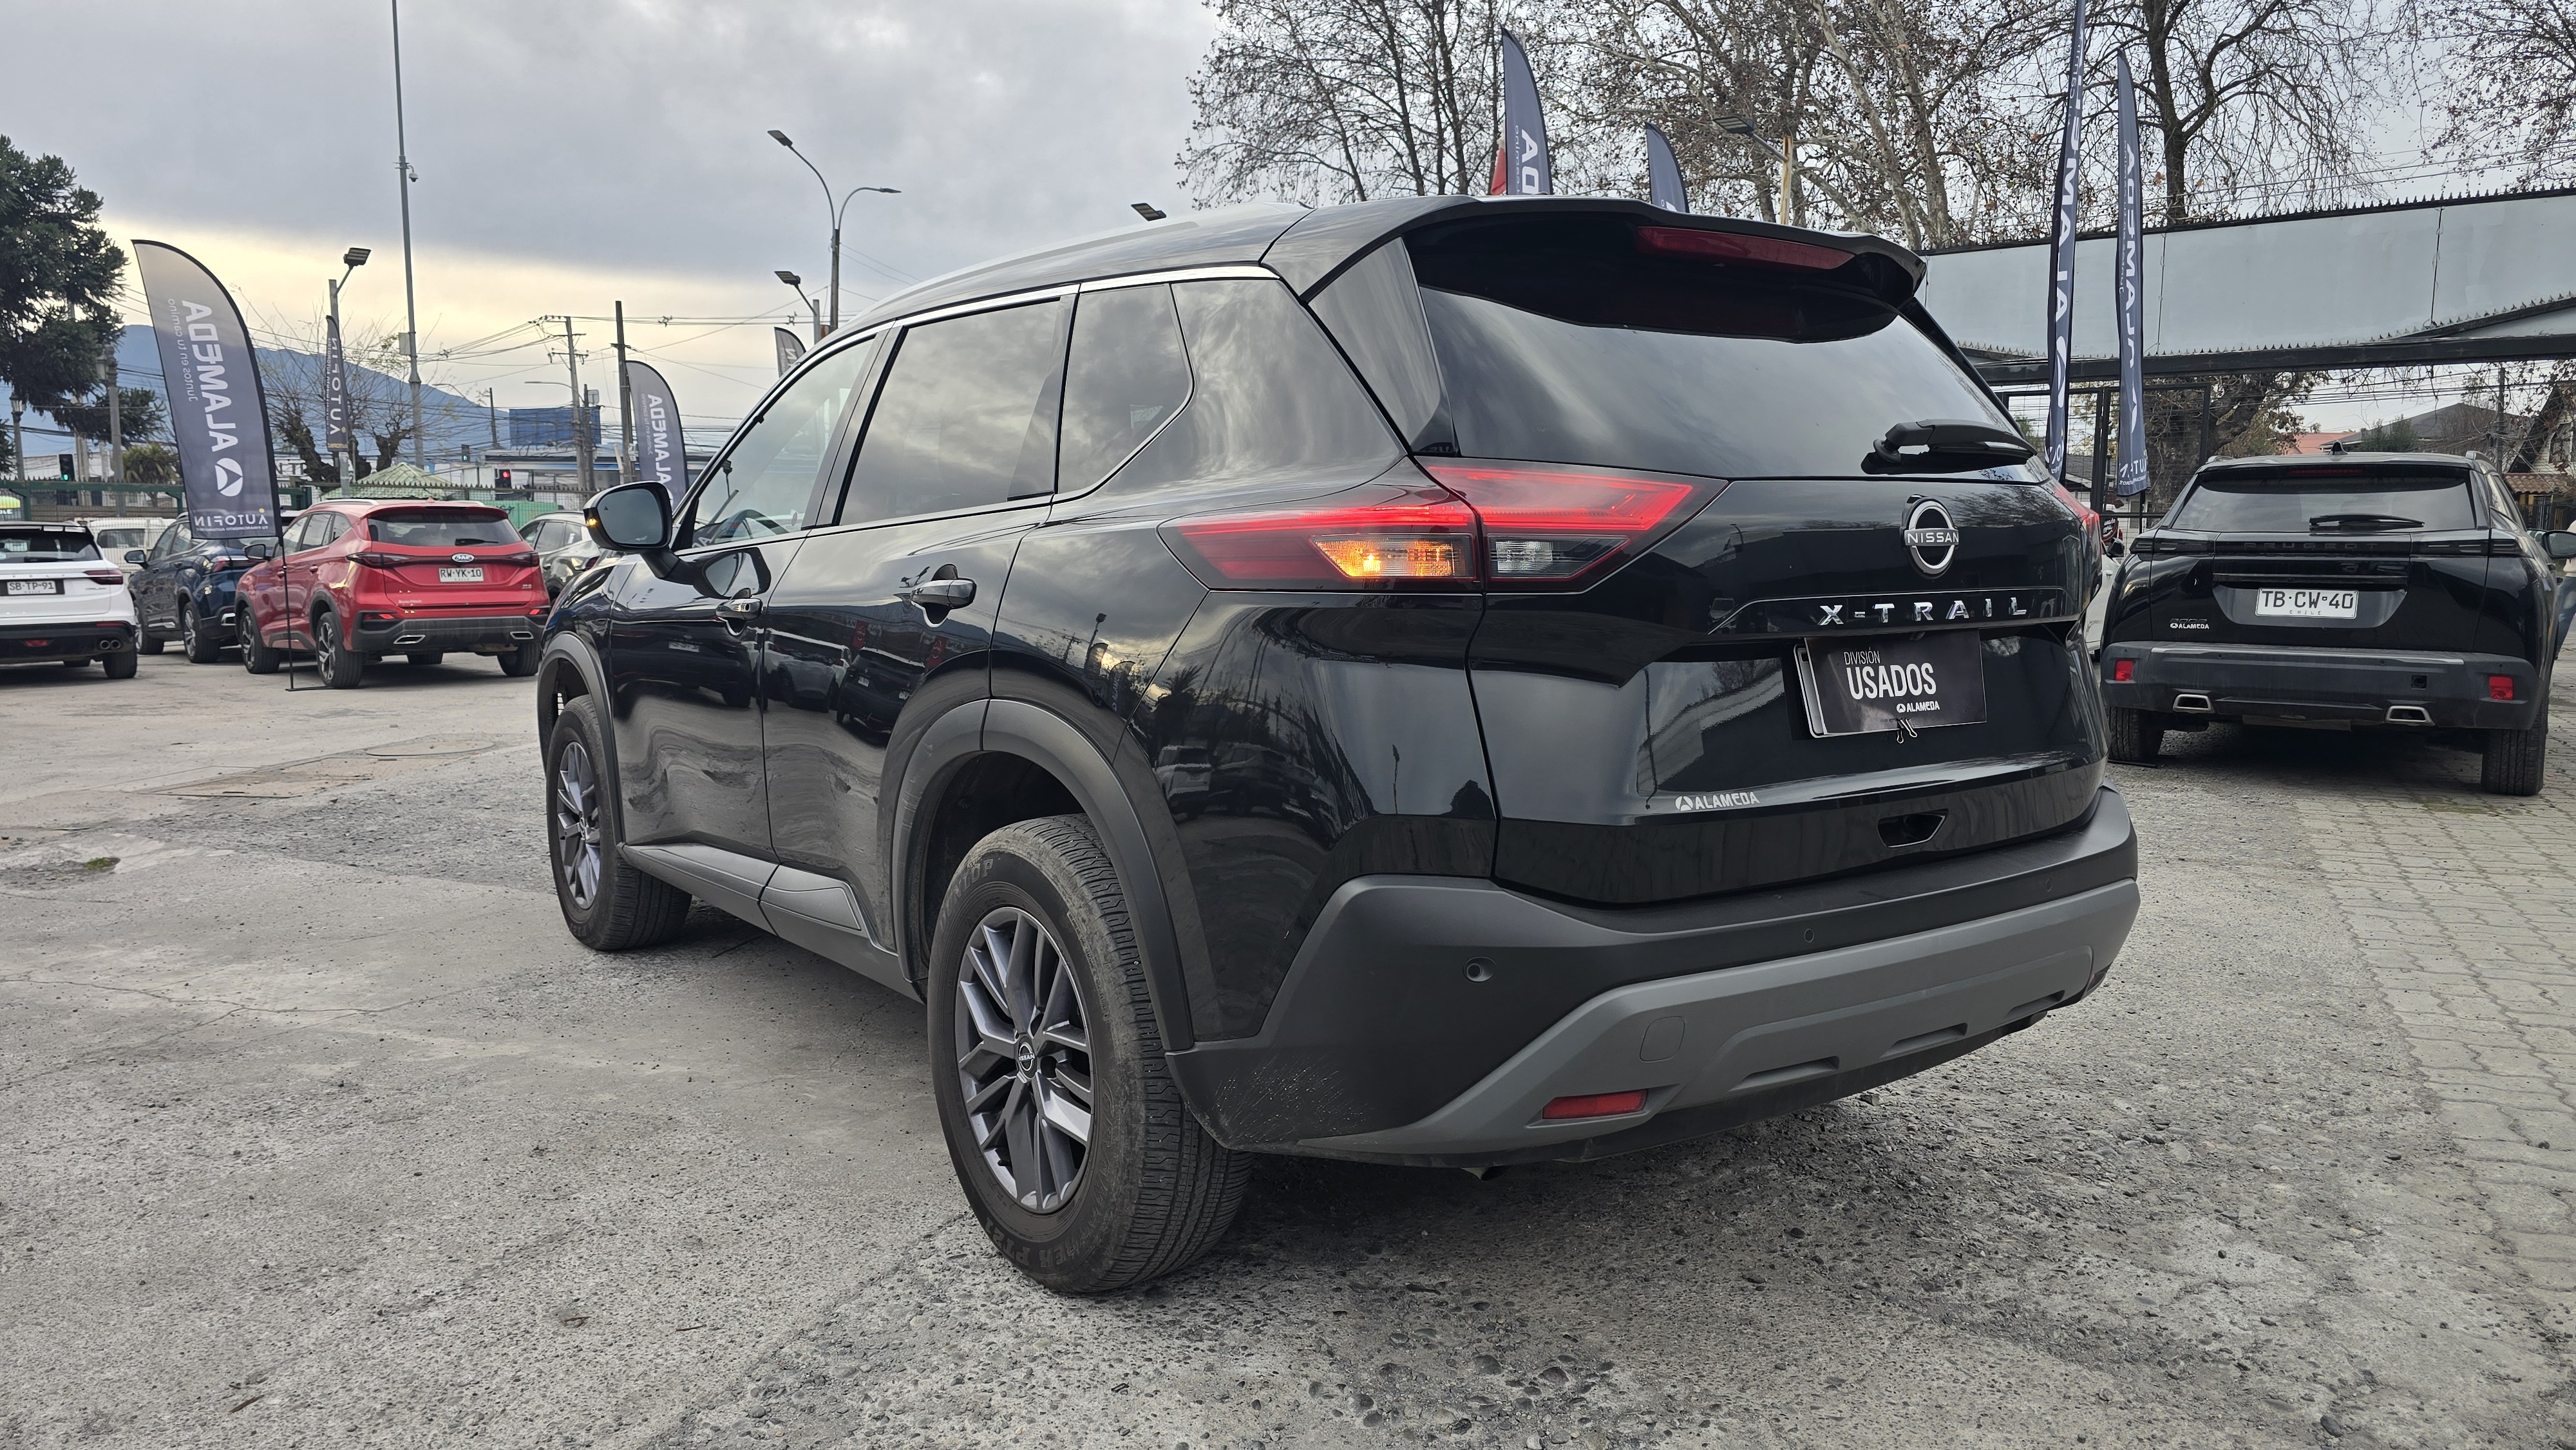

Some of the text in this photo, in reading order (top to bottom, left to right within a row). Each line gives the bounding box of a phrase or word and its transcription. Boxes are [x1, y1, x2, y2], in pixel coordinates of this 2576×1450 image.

[1908, 532, 1959, 543] NISSAN
[1819, 597, 2027, 626] X-TRAIL
[1844, 646, 1881, 665] DIVISIÓN
[1846, 663, 1937, 700] USADOS
[1906, 701, 1940, 713] ALAMEDA
[1695, 791, 1761, 810] ALAMEDA
